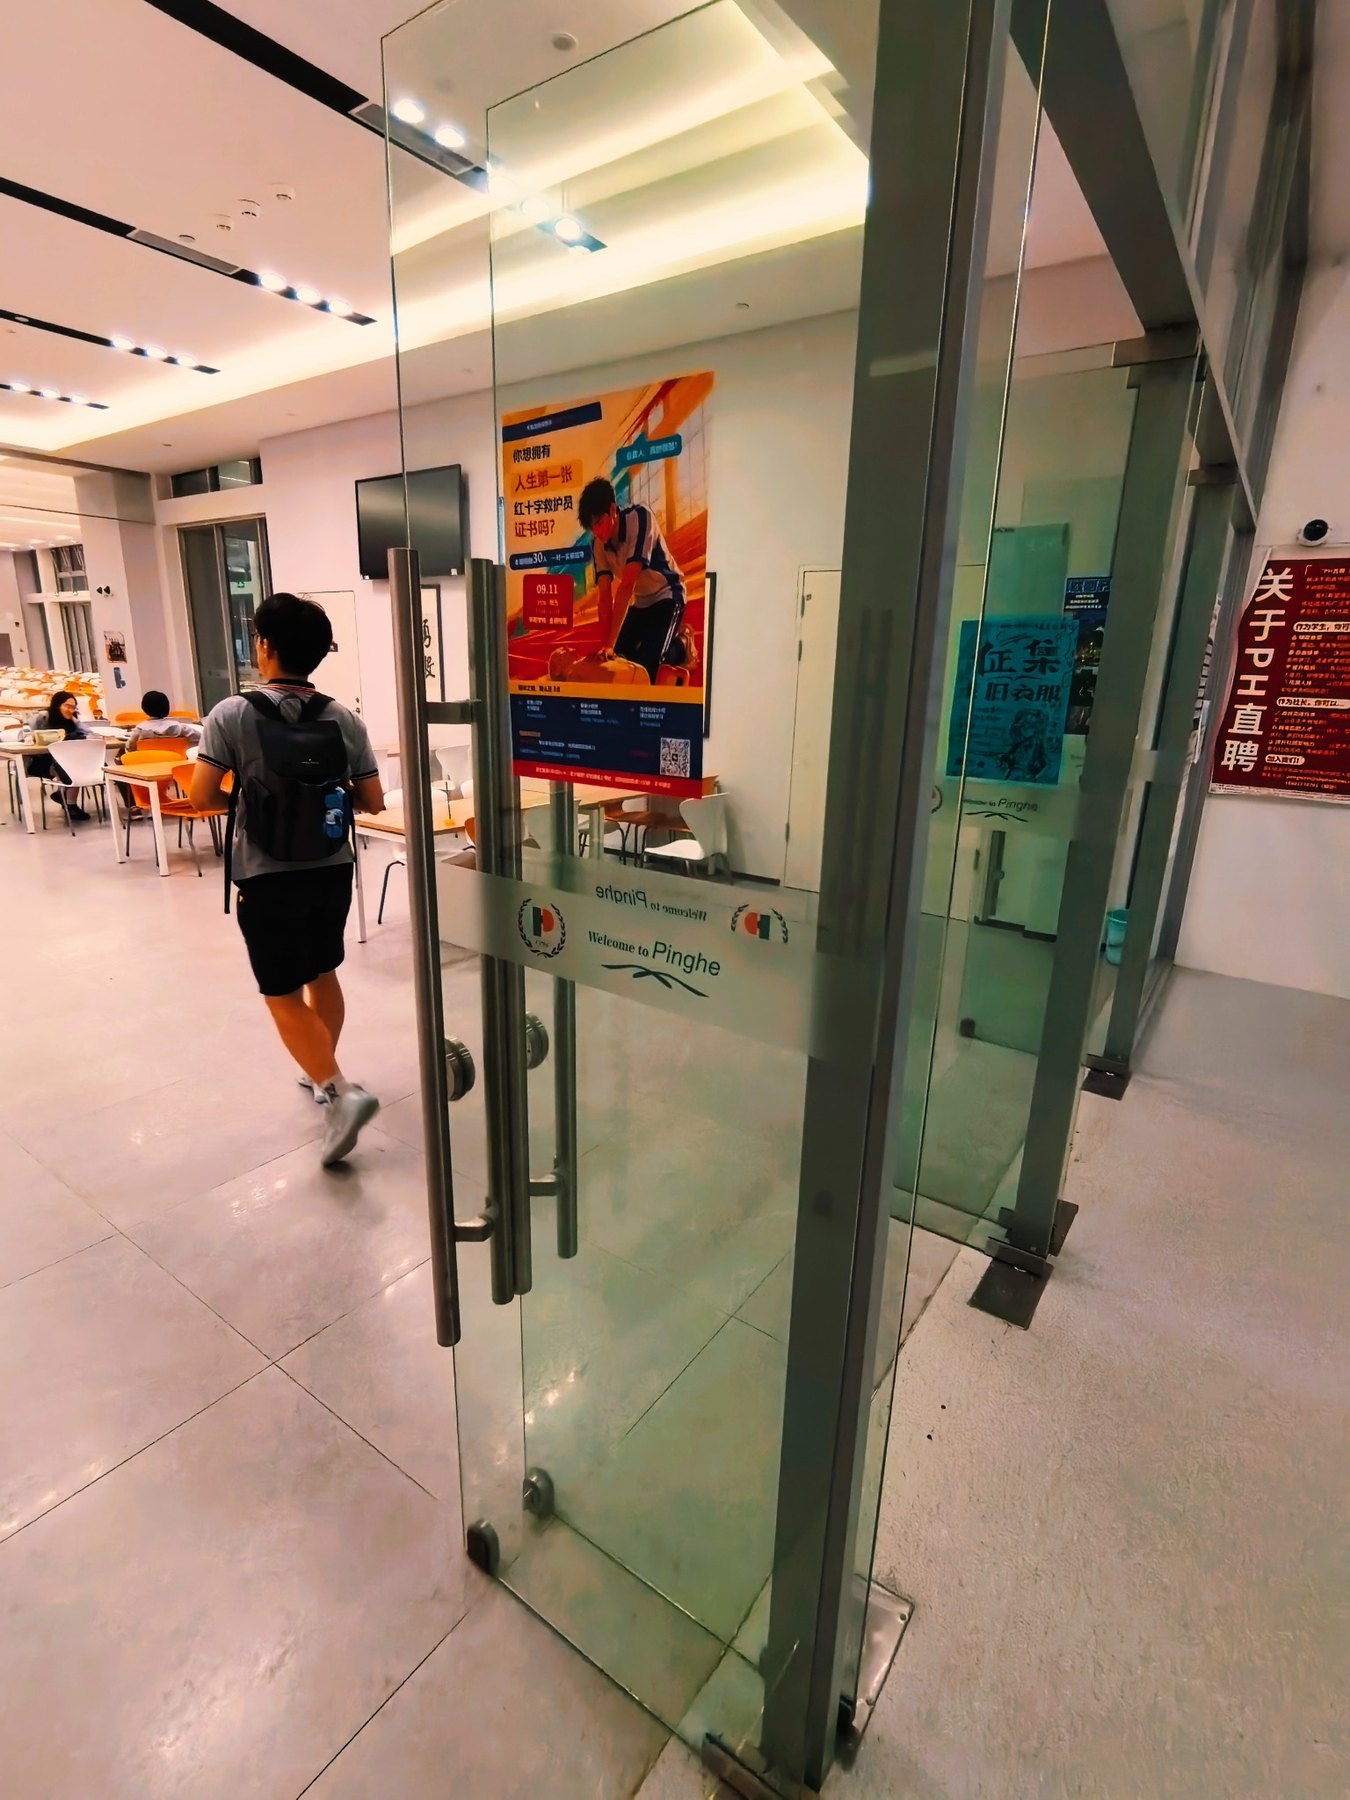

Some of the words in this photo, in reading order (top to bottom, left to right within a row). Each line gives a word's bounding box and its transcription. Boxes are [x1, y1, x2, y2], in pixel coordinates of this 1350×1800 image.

[513, 444, 551, 463] 你想拥有
[514, 466, 573, 492] 人生第一张
[513, 496, 573, 516] 红十字救护员
[536, 583, 558, 595] 09.11
[1221, 567, 1294, 773] 关于PH直聘
[985, 682, 1062, 702] 旧衣服
[998, 798, 1038, 812] Pinghe
[588, 931, 635, 954] Welcome
[637, 944, 649, 958] to
[652, 941, 721, 976] Pinghe
